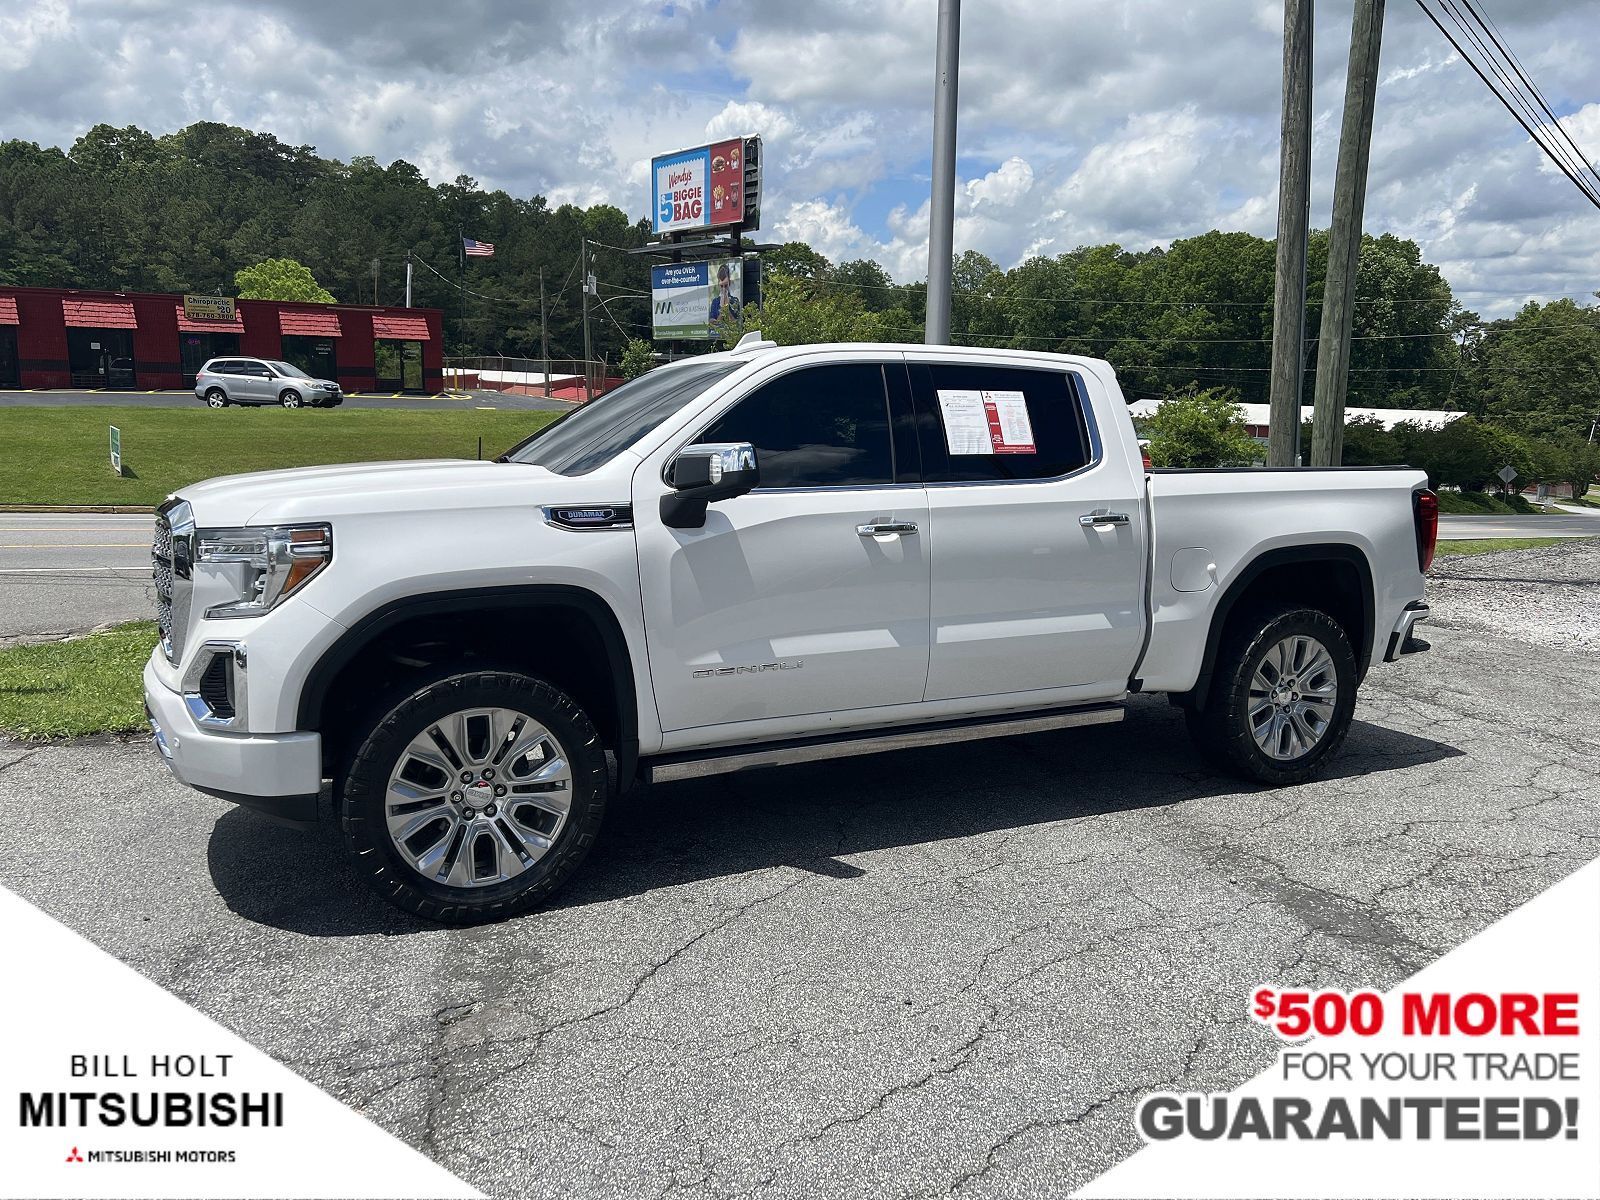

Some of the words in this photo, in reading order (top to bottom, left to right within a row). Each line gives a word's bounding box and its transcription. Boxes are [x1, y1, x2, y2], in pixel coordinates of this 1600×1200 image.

[673, 186, 702, 202] BIGGIE
[673, 199, 703, 222] BAG
[682, 266, 696, 274] OVER
[661, 274, 700, 285] over-the-counter?
[188, 297, 231, 306] Chiropractic
[568, 510, 605, 518] DURAMAX
[692, 660, 804, 679] DENALI
